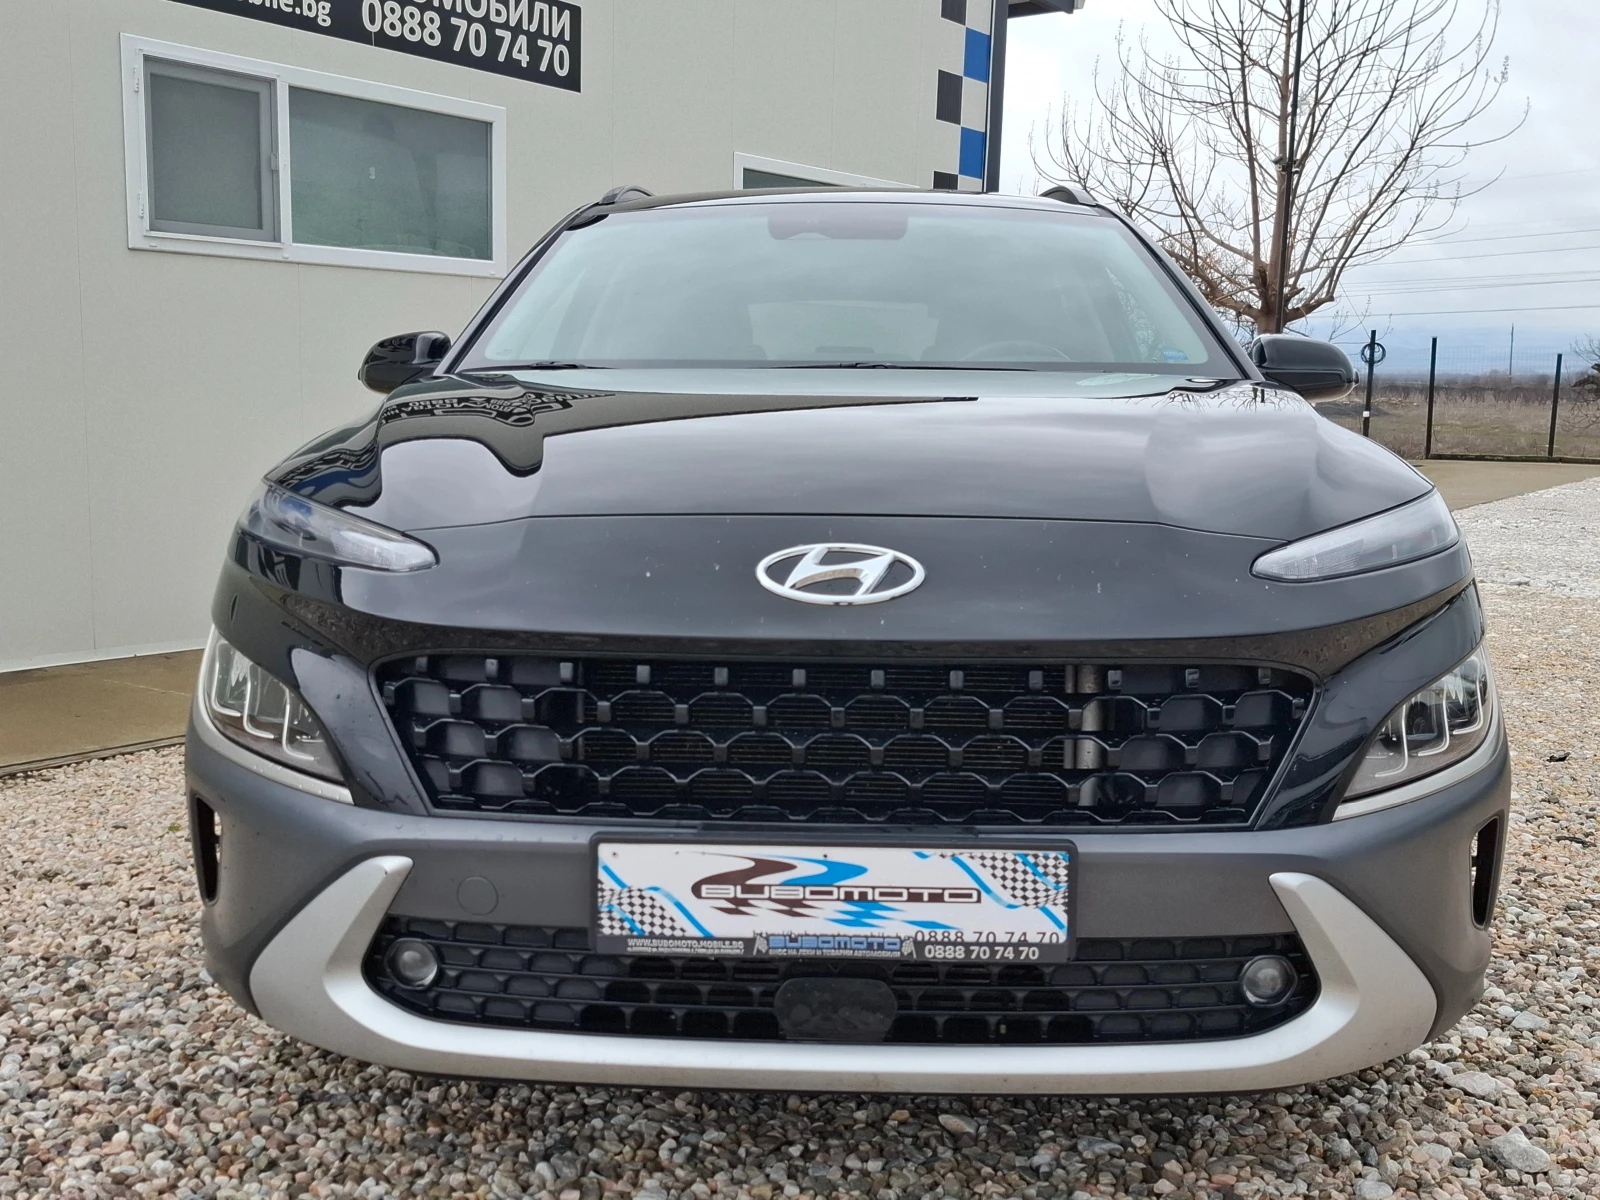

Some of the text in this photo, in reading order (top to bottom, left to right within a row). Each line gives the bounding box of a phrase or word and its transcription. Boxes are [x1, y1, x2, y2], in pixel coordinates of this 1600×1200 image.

[413, 0, 571, 41] ОБИЛИ
[361, 0, 570, 77] 0888 70 74 70
[700, 884, 978, 903] BUBOMOTO
[769, 935, 900, 950] BUBOMOTO
[915, 930, 965, 943] 0888
[973, 931, 996, 943] 70
[1036, 932, 1060, 944] 70
[924, 945, 1040, 960] 0888 70 74 70
